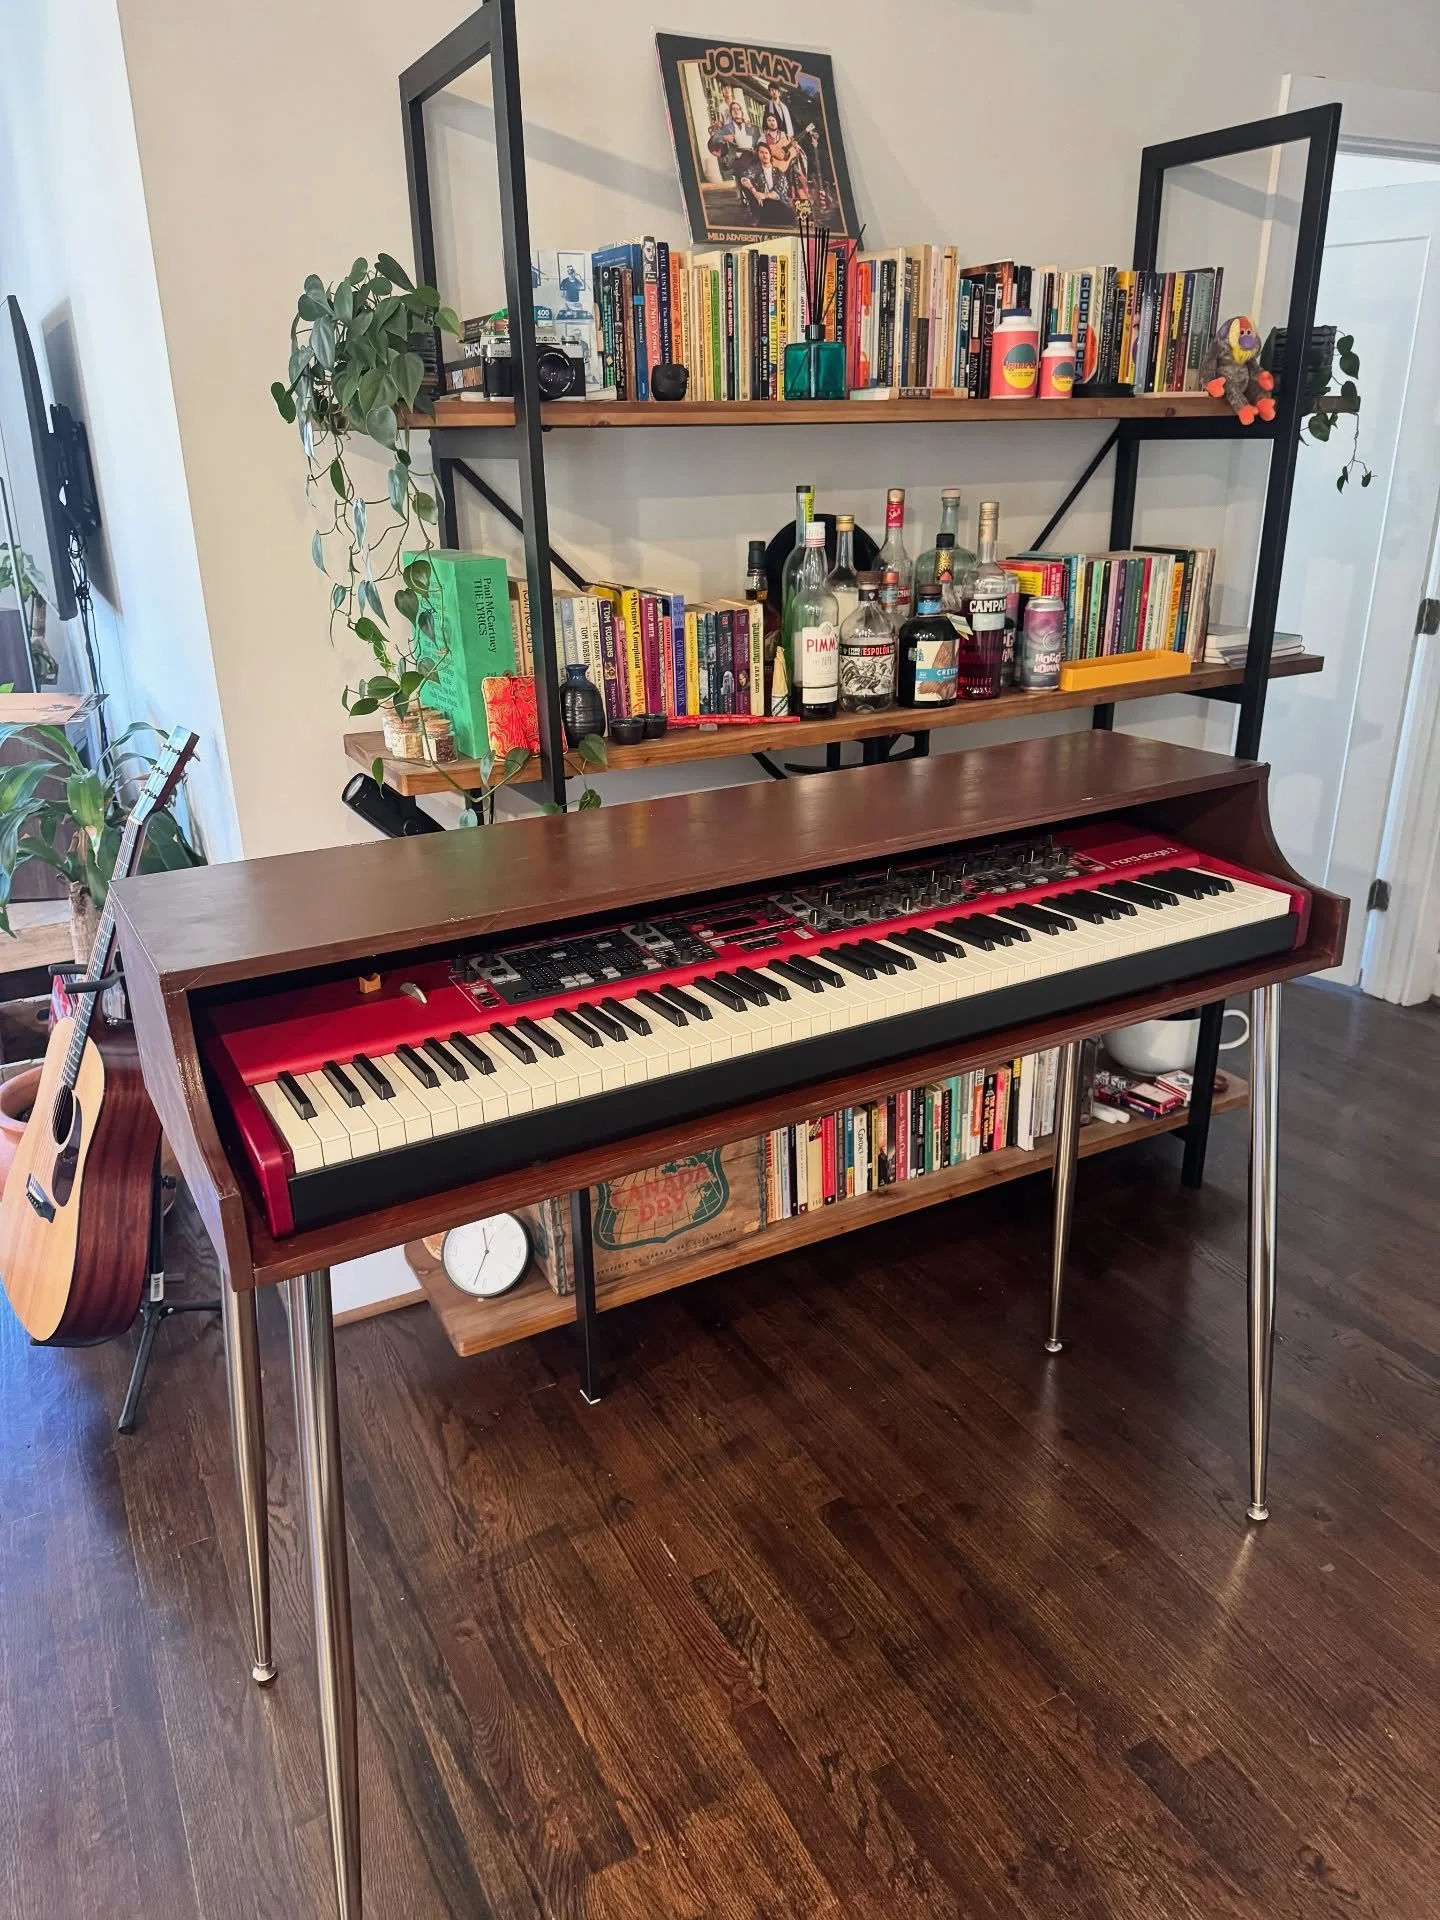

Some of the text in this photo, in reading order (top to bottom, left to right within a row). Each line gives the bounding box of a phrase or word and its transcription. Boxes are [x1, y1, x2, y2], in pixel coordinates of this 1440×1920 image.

[702, 47, 801, 88] JOE MAY
[708, 232, 725, 241] MILD
[727, 233, 763, 242] ADVERSITY
[1079, 277, 1091, 323] GOOD
[1126, 285, 1134, 315] LAND
[1183, 297, 1191, 334] MURAKAMI
[1078, 328, 1086, 343] IS
[474, 579, 487, 636] THE LYRICS
[483, 577, 497, 653] Paul McCartney
[630, 597, 639, 631] Portnoy's
[632, 632, 641, 669] Complaint
[675, 640, 684, 668] GEORGE
[635, 674, 643, 697] Philip
[858, 1128, 866, 1154] CONTACT
[611, 1163, 708, 1209] CANADA
[639, 1192, 686, 1222] DRY
